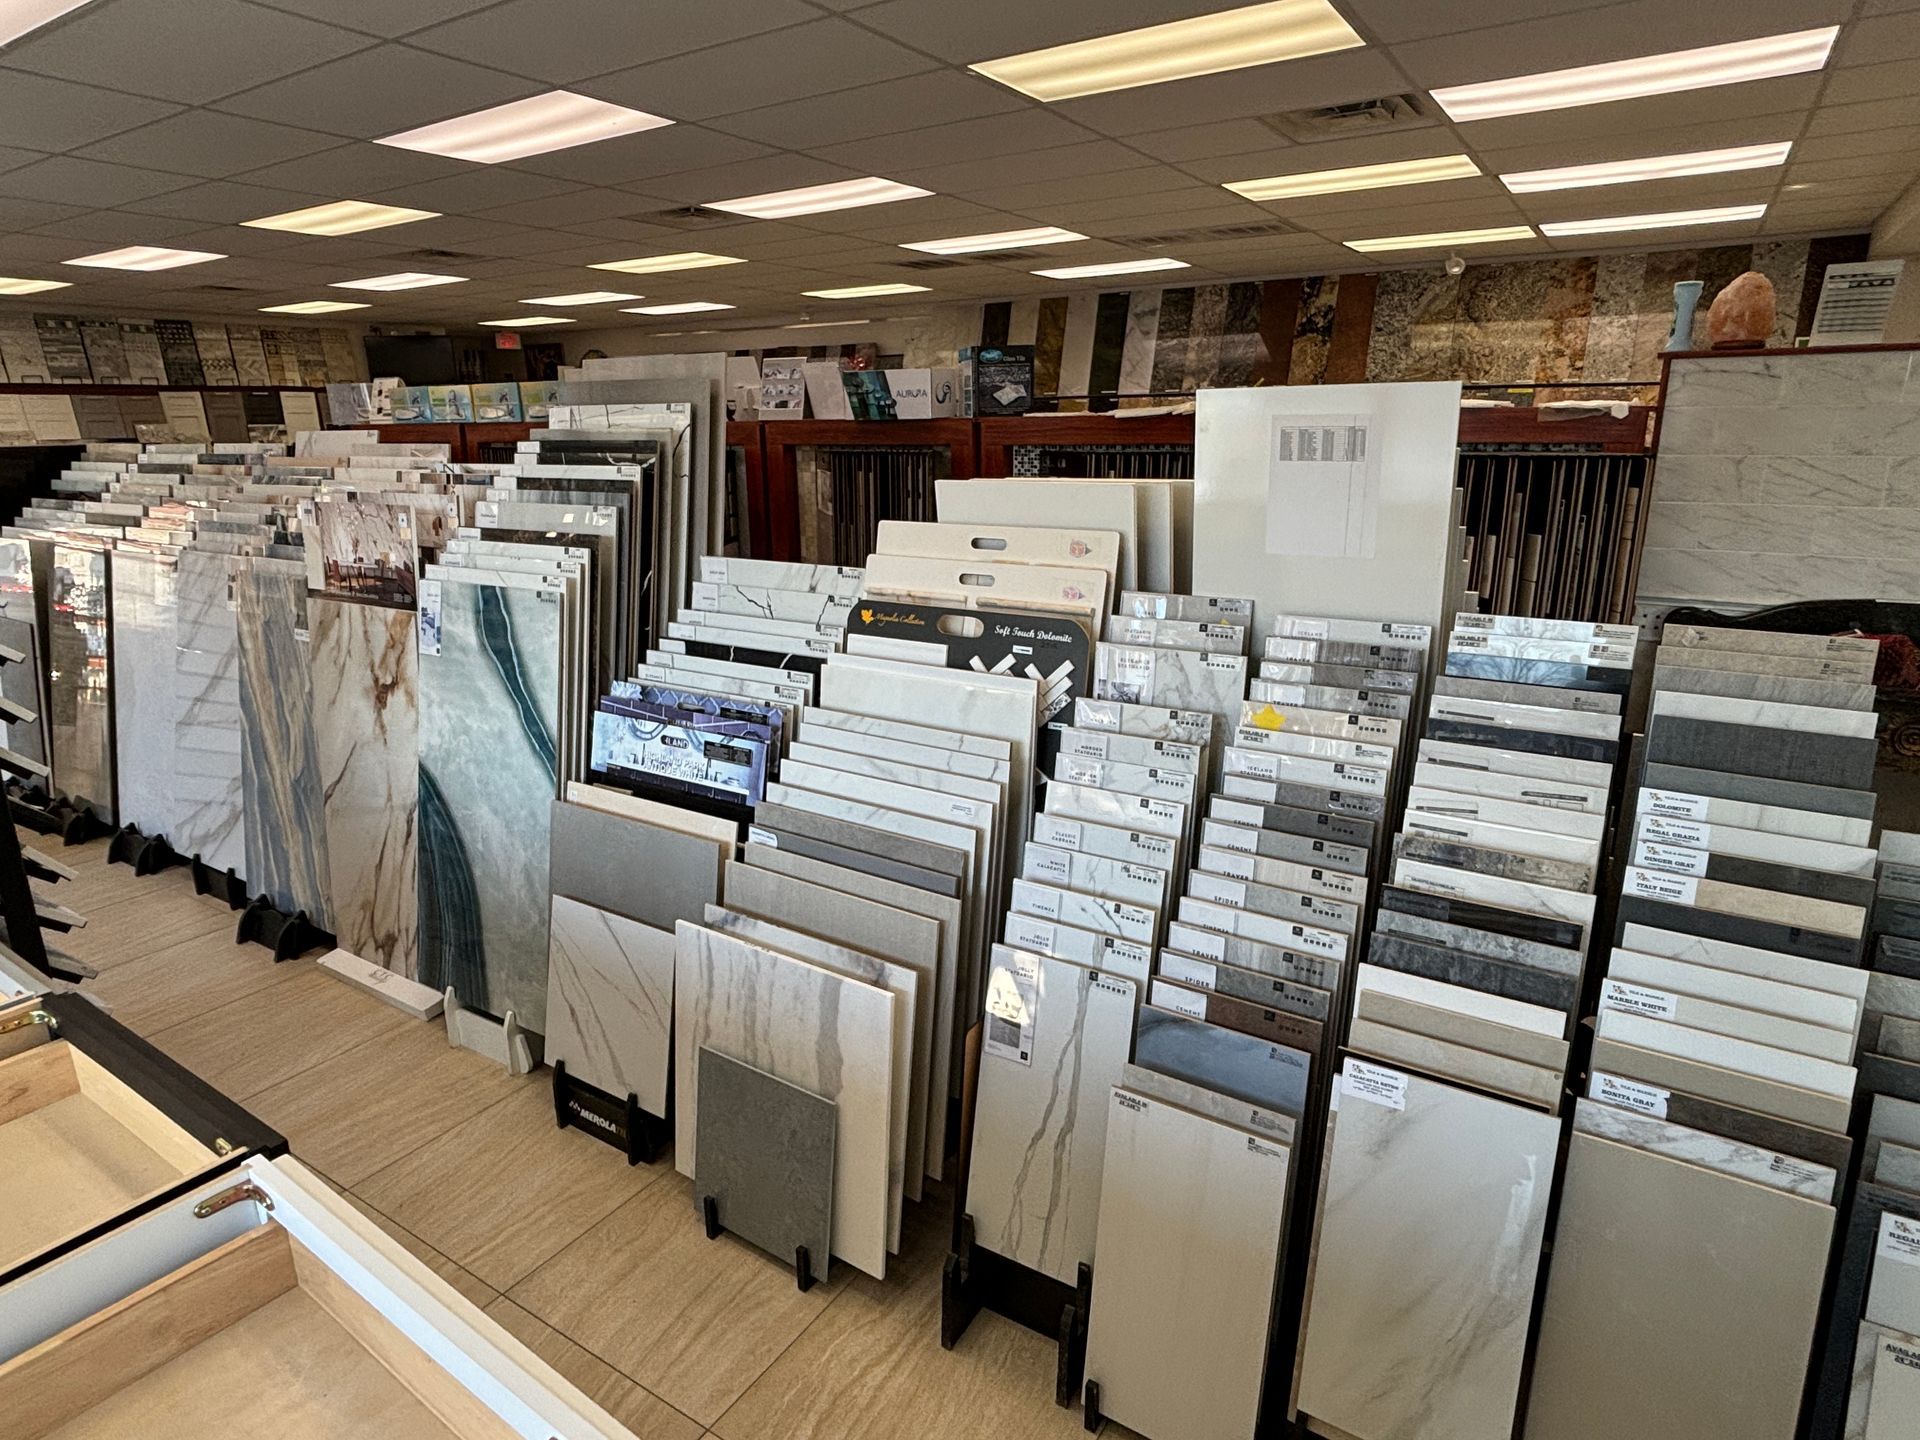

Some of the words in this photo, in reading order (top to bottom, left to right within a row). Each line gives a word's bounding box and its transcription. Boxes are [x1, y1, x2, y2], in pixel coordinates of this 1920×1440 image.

[994, 624, 1011, 637] Soft
[1012, 626, 1035, 639] Touch
[1036, 630, 1073, 643] Dolomite
[1247, 765, 1273, 774] ICELAND
[1653, 802, 1692, 813] DOLOMITE
[1646, 828, 1671, 837] REGAL
[1049, 860, 1066, 868] WHITE
[1643, 855, 1673, 865] GINGER
[1674, 861, 1696, 869] GRAY
[1636, 882, 1658, 891] ITALY
[1659, 886, 1683, 895] BEIGE
[1213, 895, 1240, 906] SPIDER
[1033, 933, 1050, 942] JOLLY
[1192, 949, 1219, 961] TRAVER
[1185, 976, 1210, 988] SPIDER
[1607, 994, 1640, 1006] MARBLE
[1641, 1001, 1668, 1013] WHITE
[1175, 1005, 1201, 1016] CEMENT
[1348, 1073, 1380, 1085] CALACATTA
[1601, 1088, 1631, 1101] BONITA
[1632, 1097, 1656, 1108] GRAY
[580, 1108, 616, 1133] MEROLA
